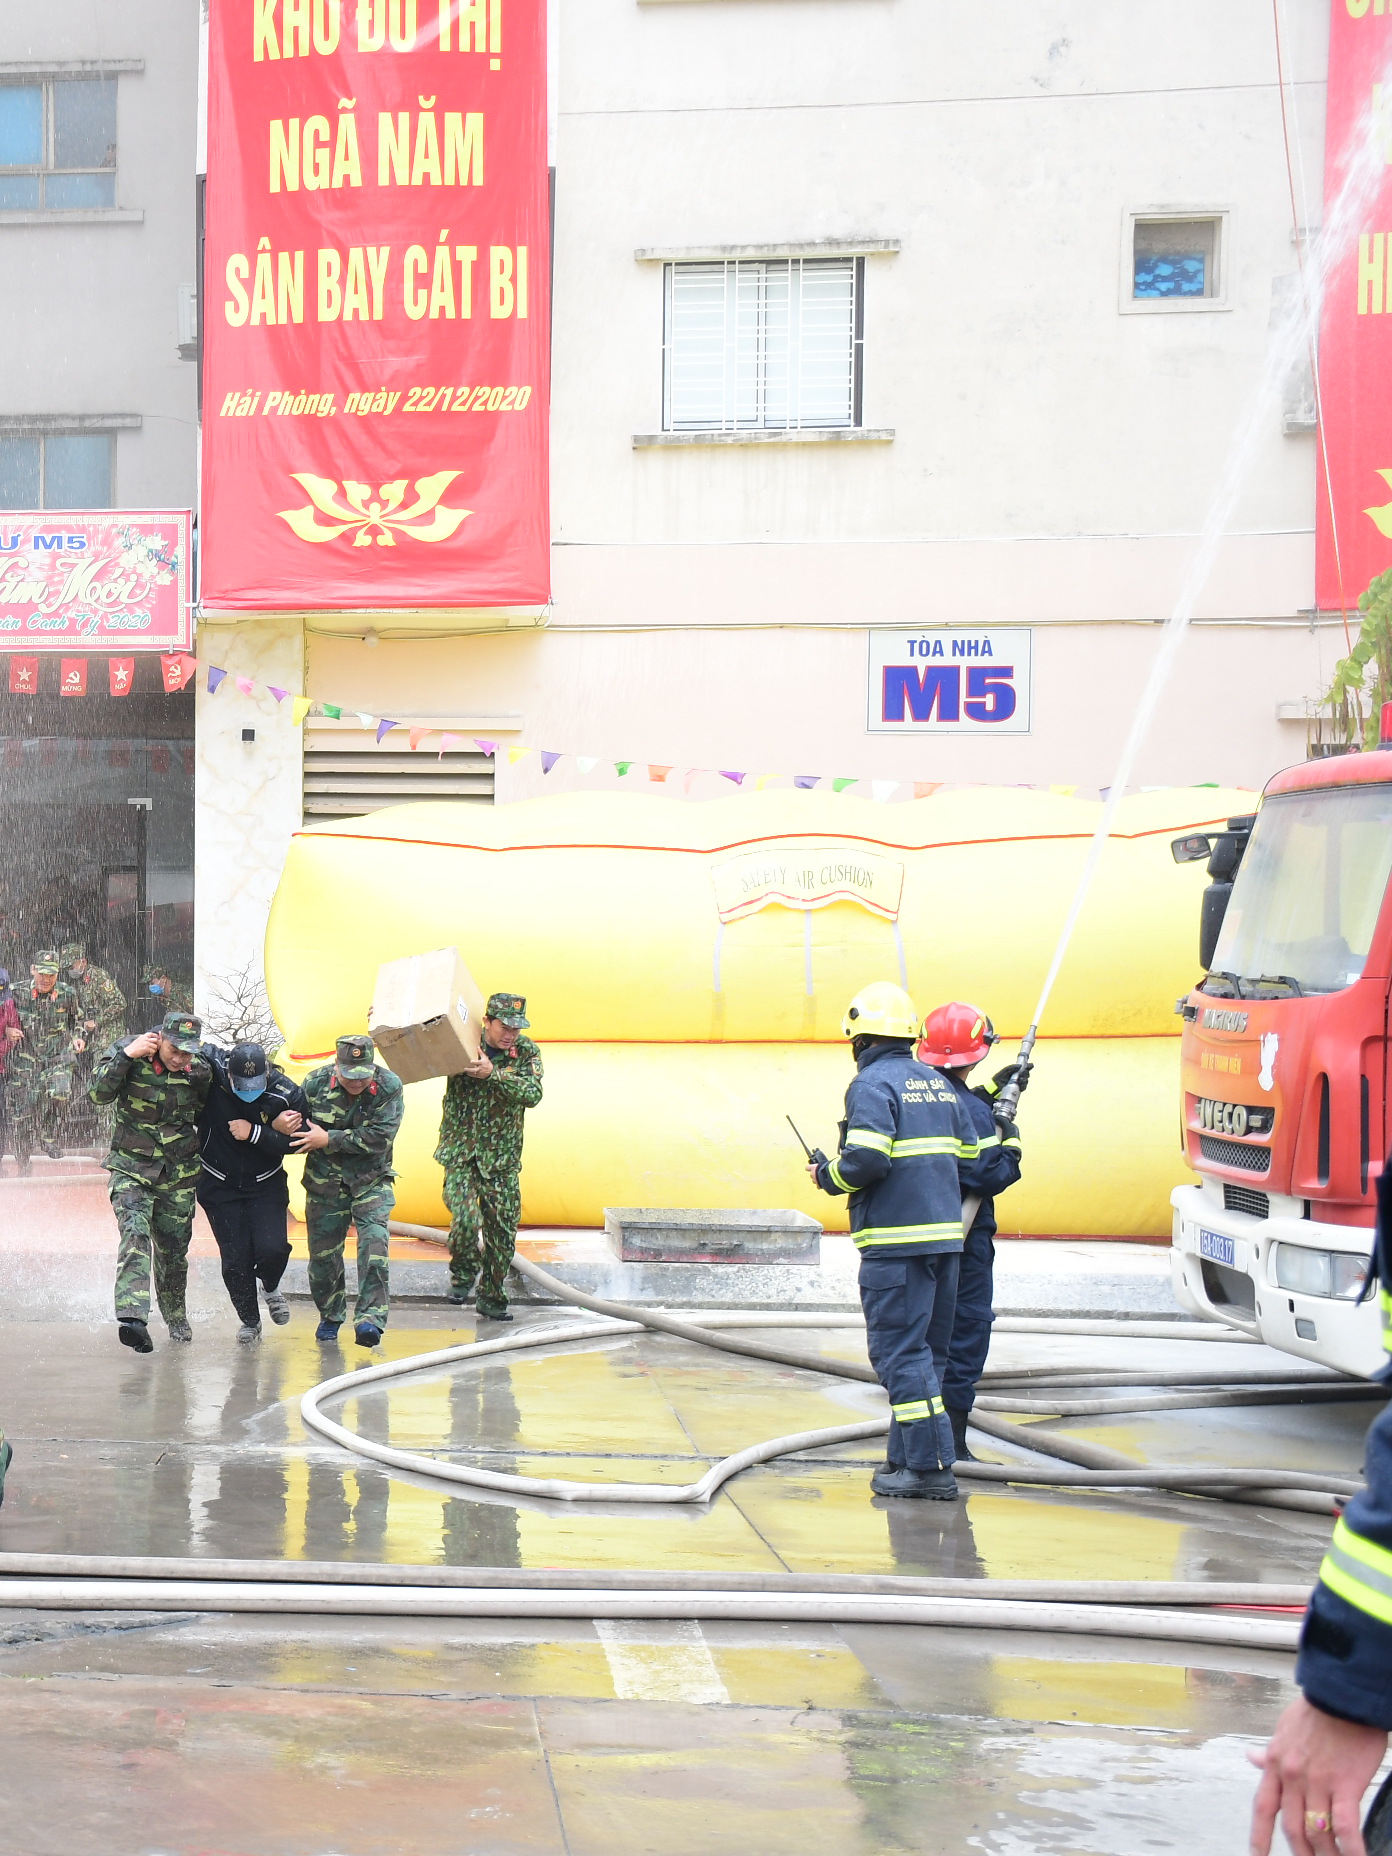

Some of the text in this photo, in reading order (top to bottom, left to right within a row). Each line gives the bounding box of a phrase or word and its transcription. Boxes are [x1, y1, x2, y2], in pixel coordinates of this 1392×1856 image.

[269, 95, 484, 193] NGÃ NĂM
[224, 229, 528, 327] SÂN BAY CÁT BI
[219, 388, 261, 417] Hải
[343, 386, 401, 416] ngày
[402, 386, 532, 412] 22/12/2020
[33, 535, 87, 550] M5
[38, 556, 151, 614] Mới
[26, 613, 68, 630] Canh
[106, 612, 152, 630] 2020
[907, 635, 993, 657] TÒA NHÀ
[882, 665, 1016, 723] M5
[741, 864, 874, 893] SAFETY AIR CUSHION
[1199, 1098, 1248, 1137] IVECO
